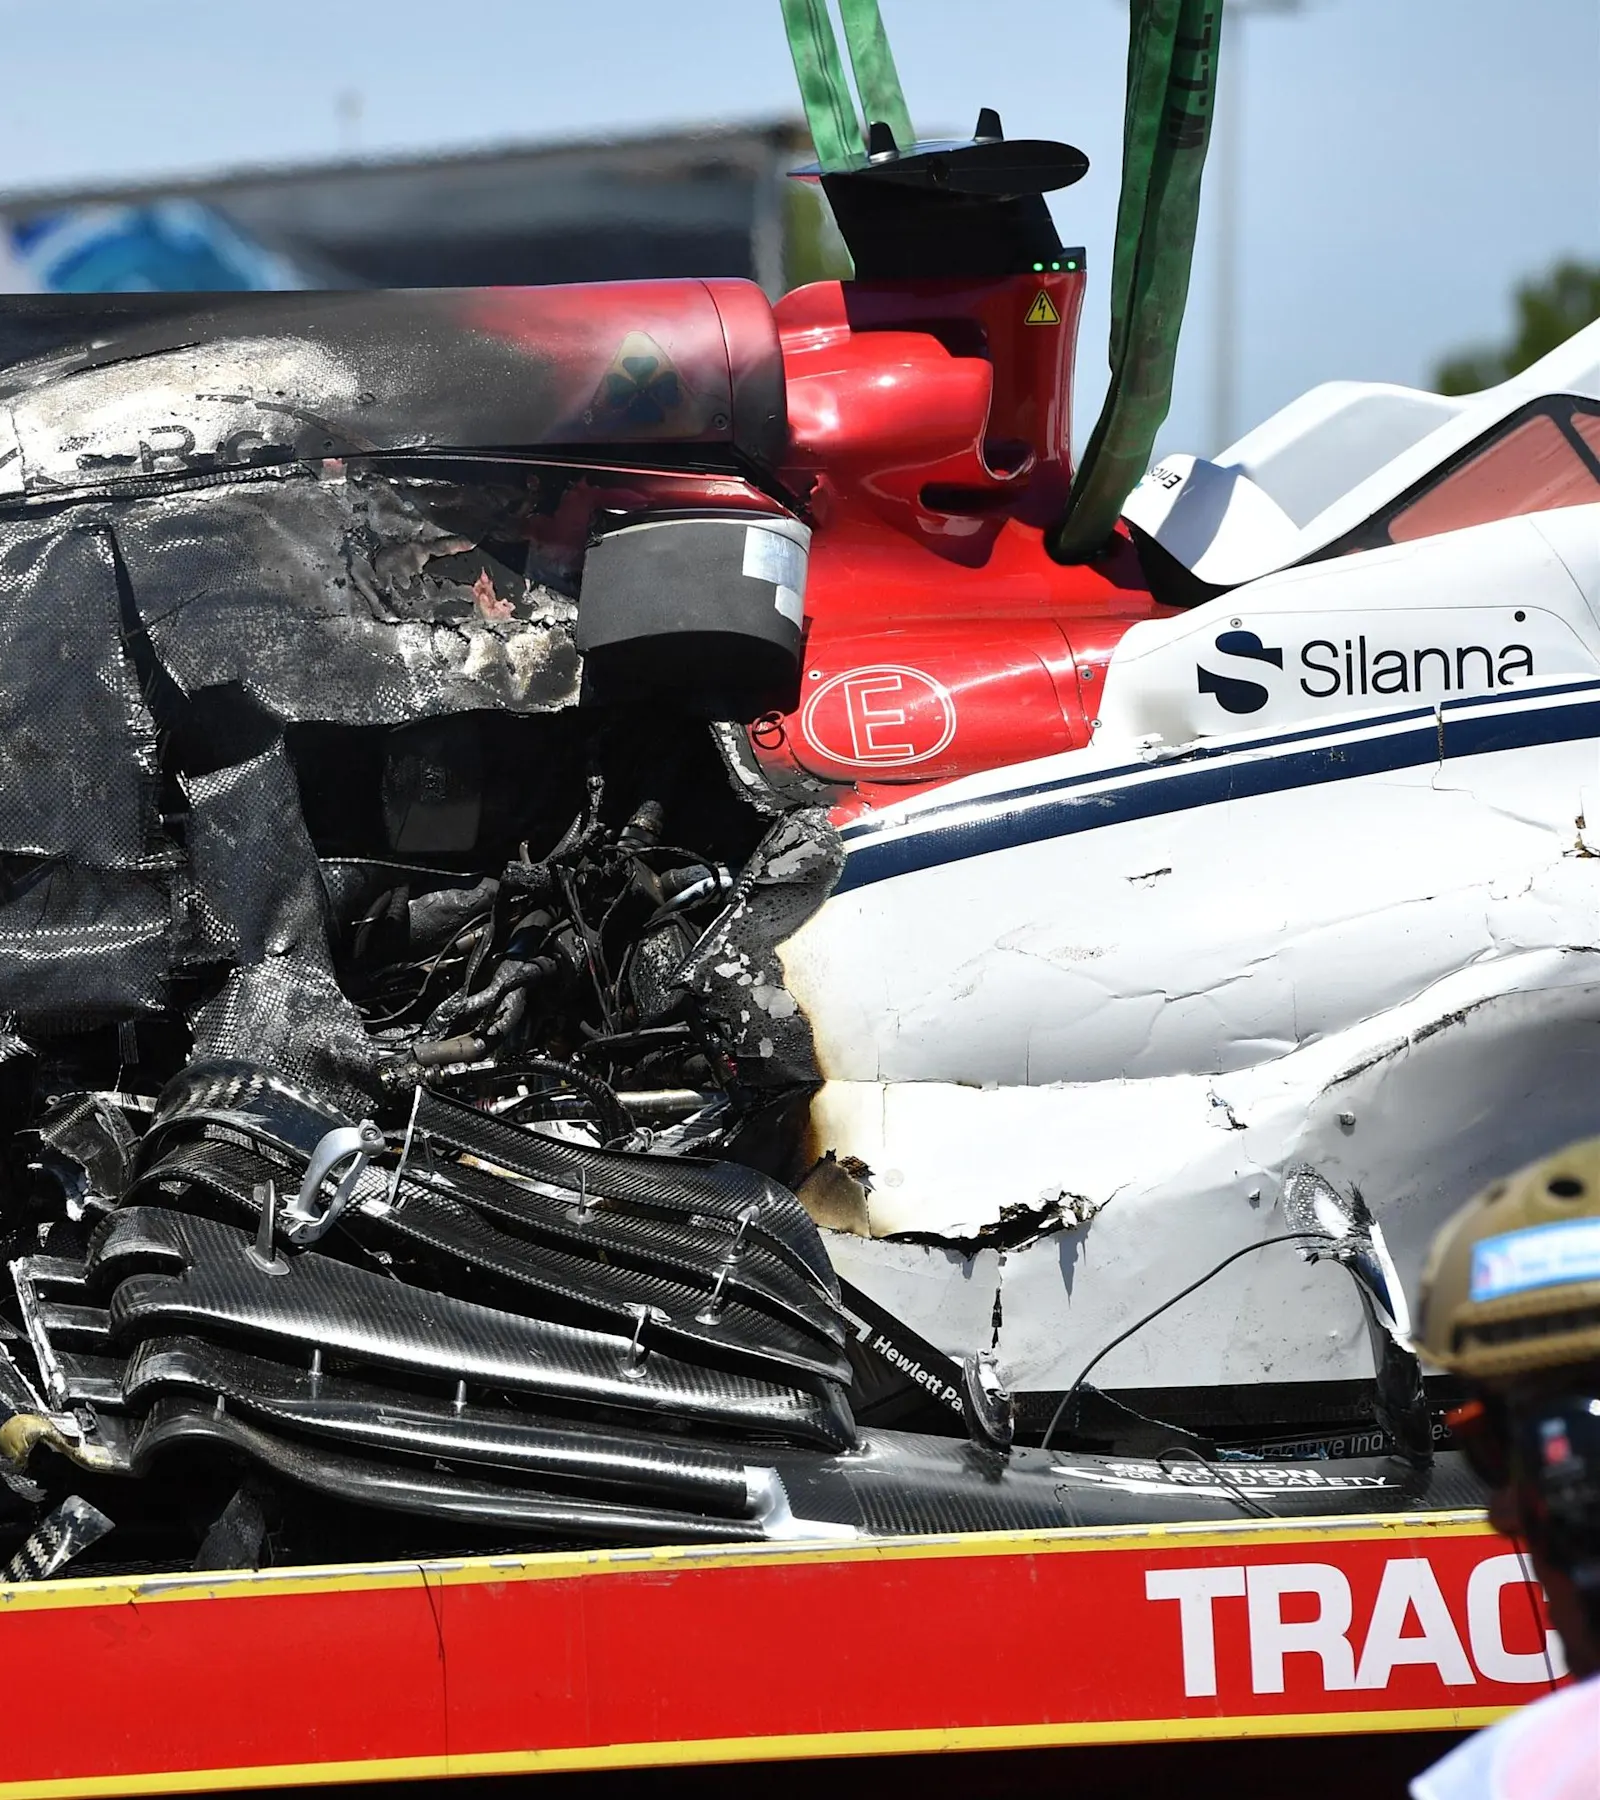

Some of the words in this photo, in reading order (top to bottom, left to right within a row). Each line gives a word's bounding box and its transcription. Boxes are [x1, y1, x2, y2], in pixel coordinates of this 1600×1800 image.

[1299, 635, 1534, 698] Silanna
[872, 1334, 943, 1395] Hewlett
[940, 1386, 966, 1416] Pa
[1114, 1471, 1161, 1479] FOR
[1166, 1474, 1257, 1485] ROAD
[1264, 1476, 1387, 1486] SAFETY
[1171, 1466, 1321, 1478] ACTION
[1145, 1552, 1568, 1698] TRAC
